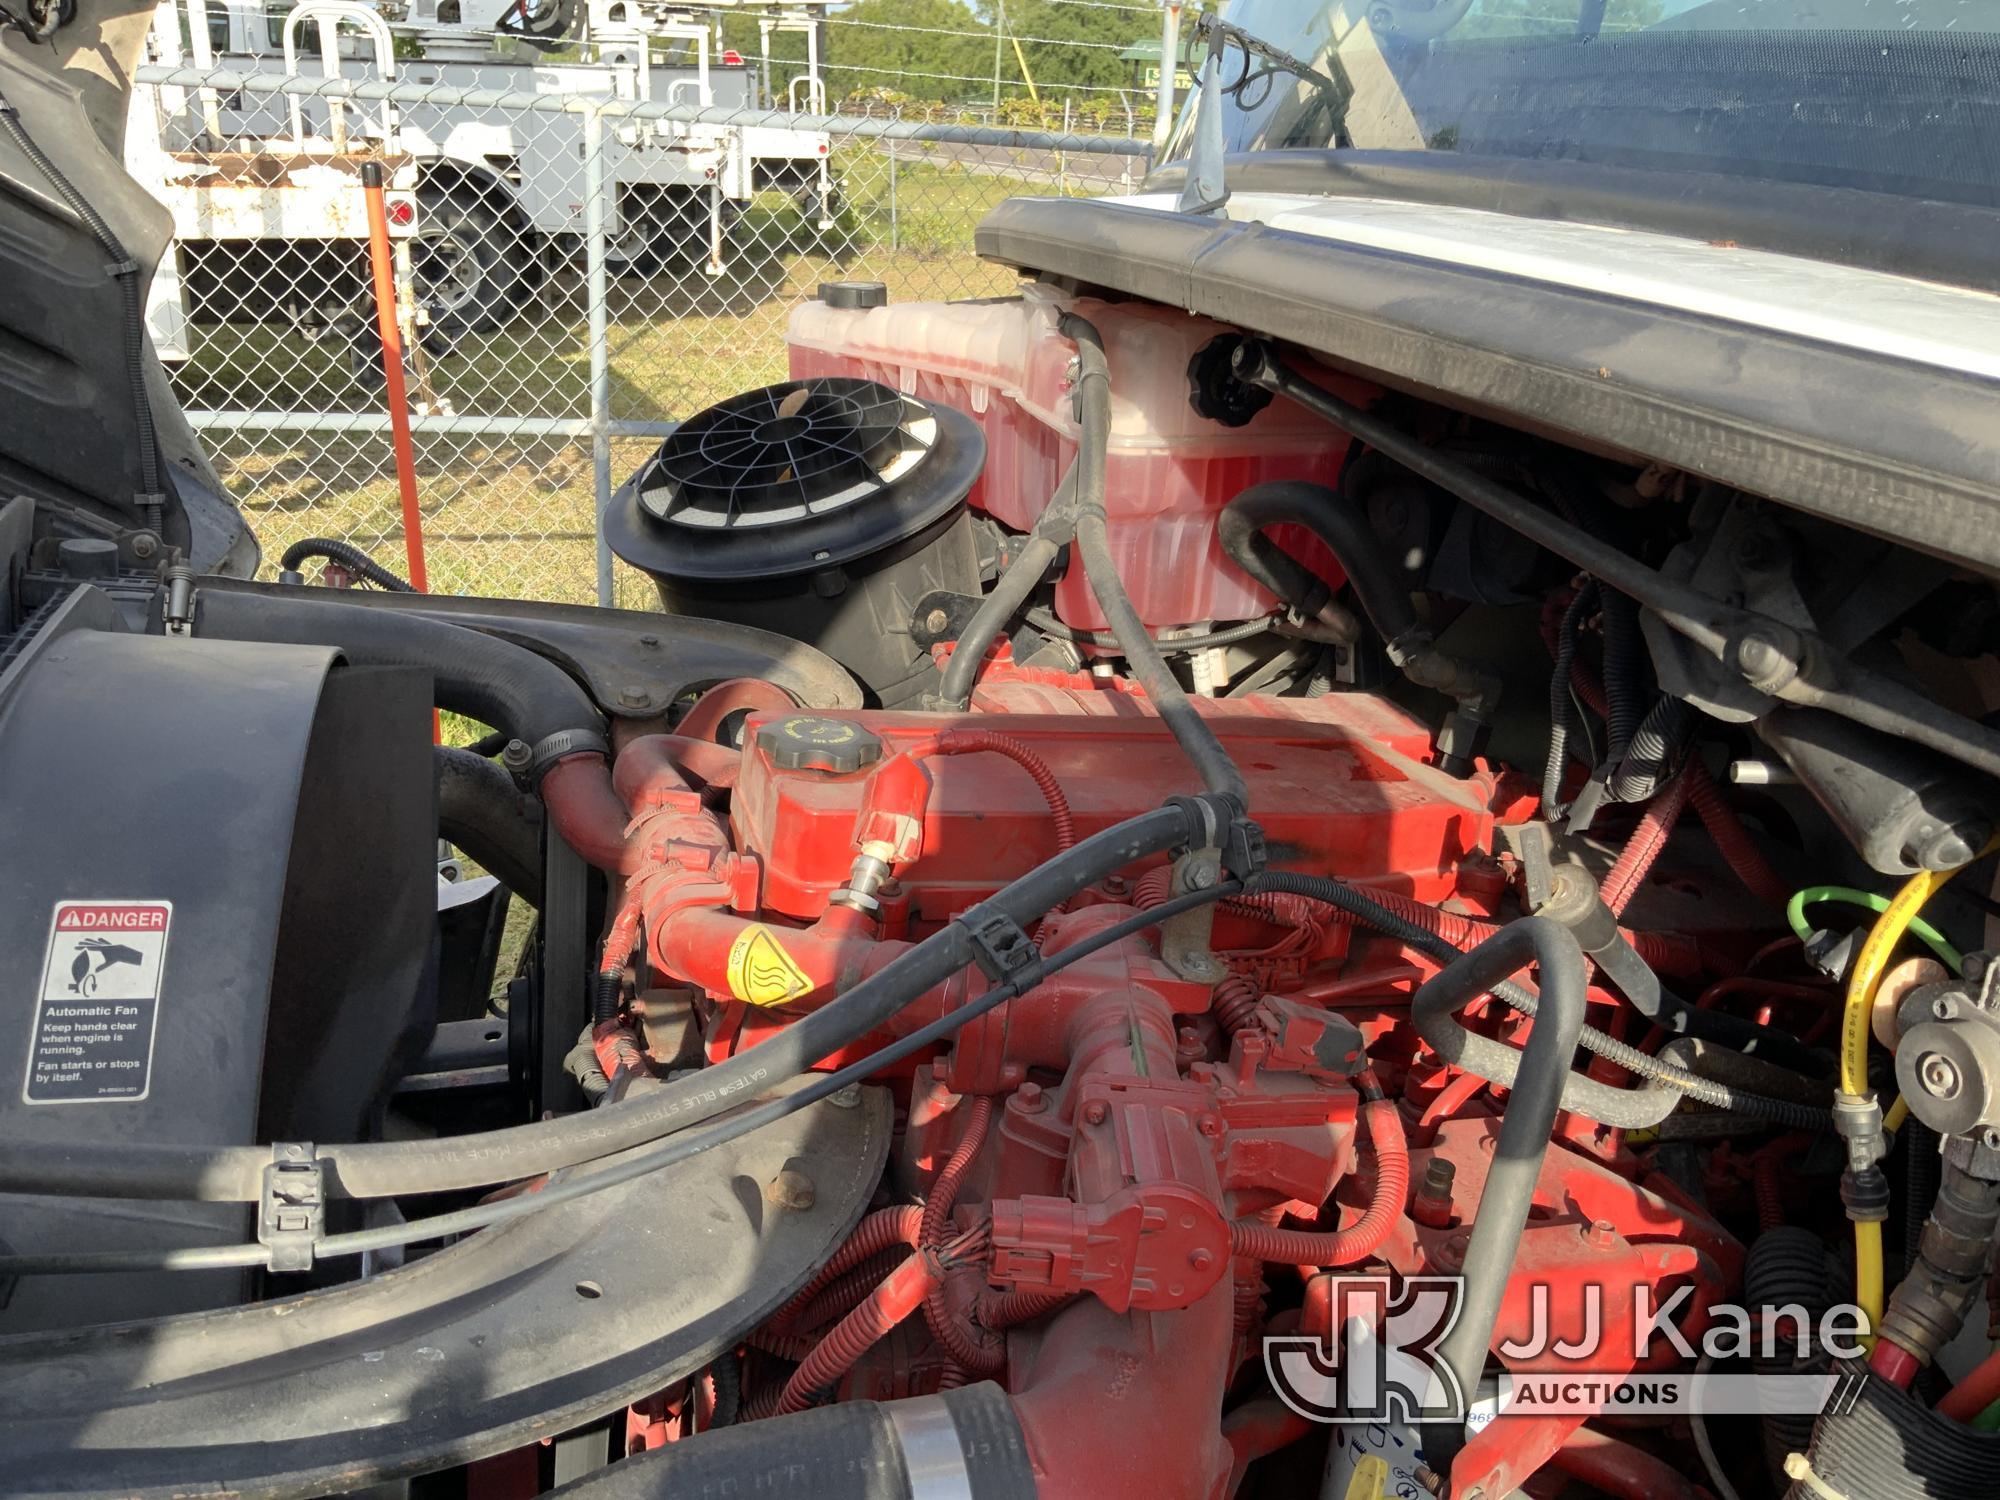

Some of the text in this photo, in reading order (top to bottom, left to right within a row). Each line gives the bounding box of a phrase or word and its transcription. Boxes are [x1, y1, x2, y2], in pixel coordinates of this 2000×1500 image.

[82, 911, 164, 928] DANGER
[46, 1005, 138, 1017] Automatic Fan
[43, 1022, 138, 1033] Keep hands clear
[41, 1033, 124, 1044] when engine is
[40, 1046, 86, 1055] running.
[37, 1060, 140, 1071] Fan starts or stops
[36, 1072, 83, 1084] by itself.
[684, 1091, 717, 1110] BLUE
